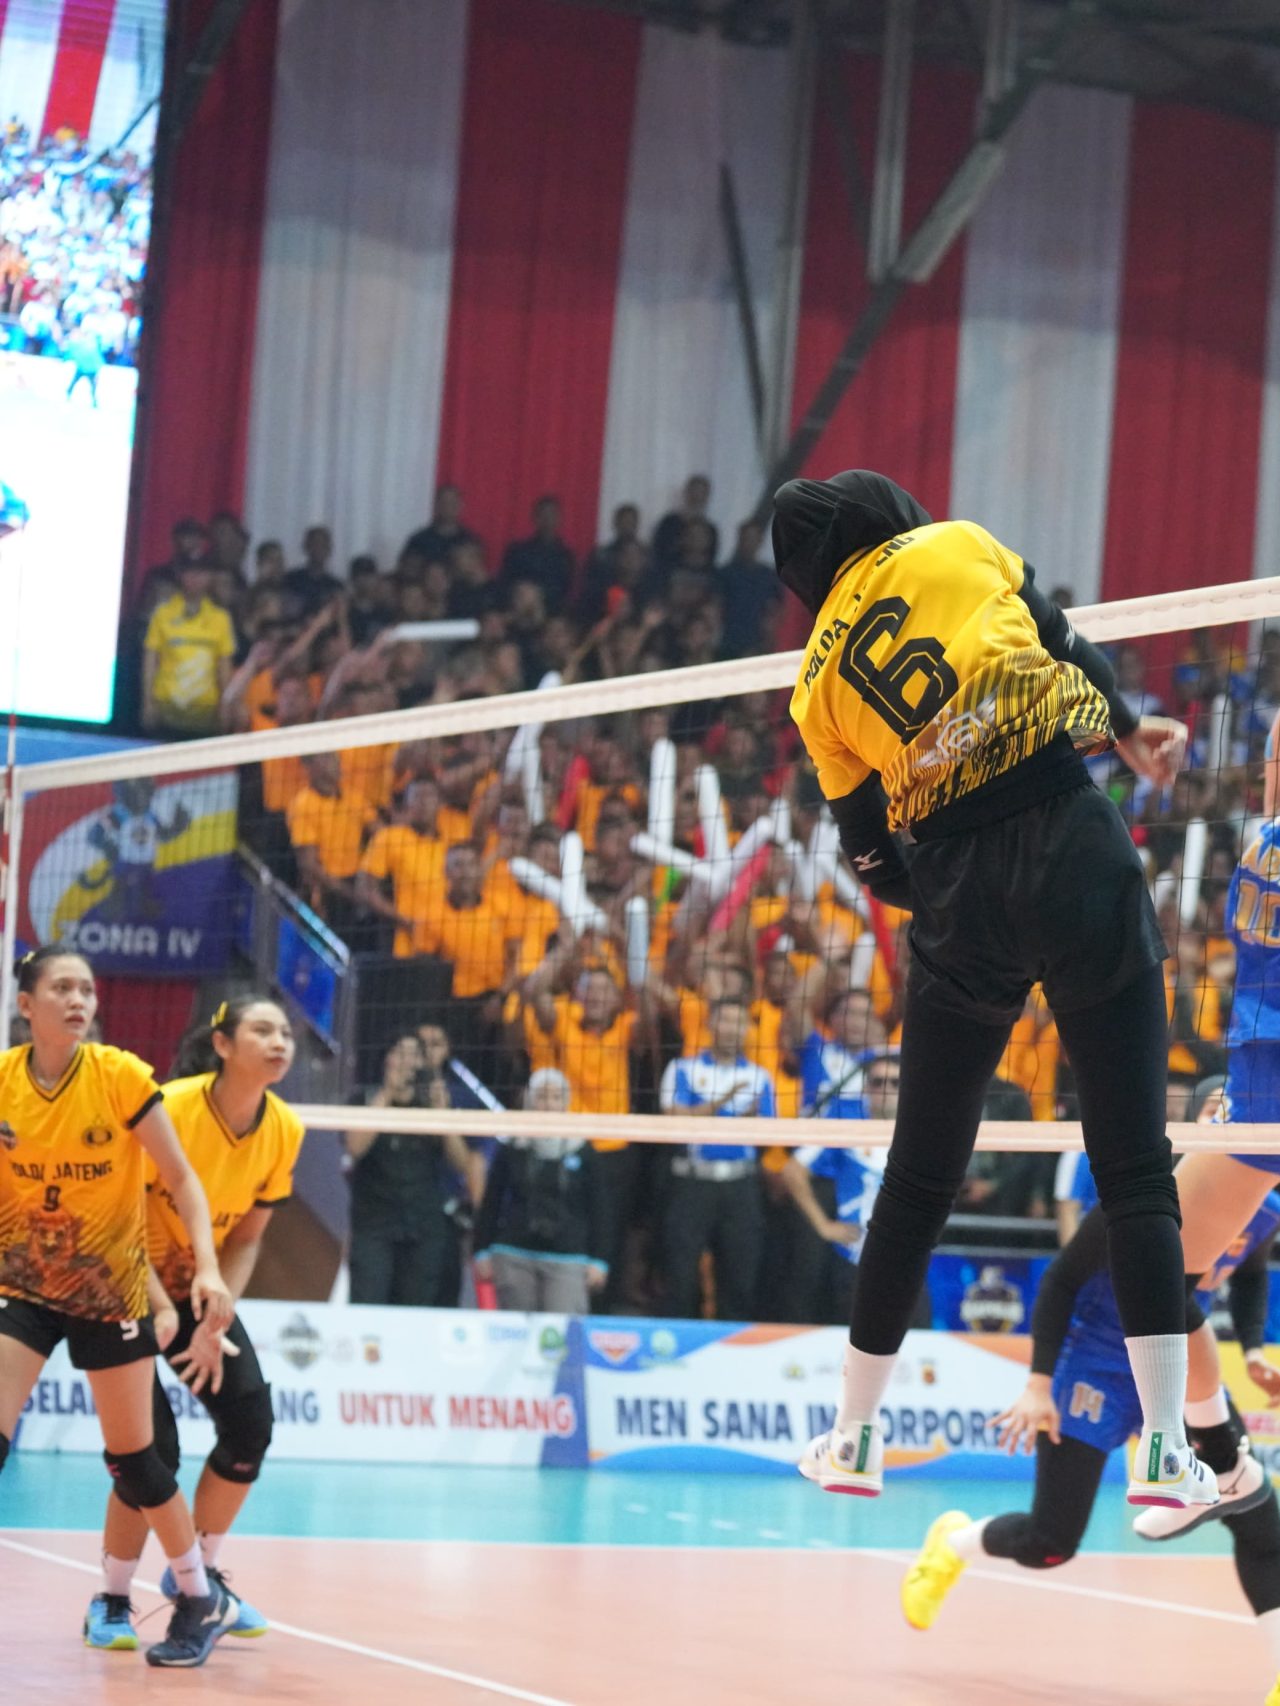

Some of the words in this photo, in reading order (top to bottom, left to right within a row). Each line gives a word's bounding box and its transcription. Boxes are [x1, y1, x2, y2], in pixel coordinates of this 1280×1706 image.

[803, 618, 851, 694] POLDA
[838, 595, 960, 746] 6
[59, 921, 160, 957] ZONA
[167, 927, 202, 958] IV
[52, 1160, 113, 1181] JATENG
[339, 1391, 436, 1428] UNTUK
[448, 1396, 576, 1435] MENANG
[616, 1396, 688, 1438] MEN
[703, 1400, 793, 1442] SANA
